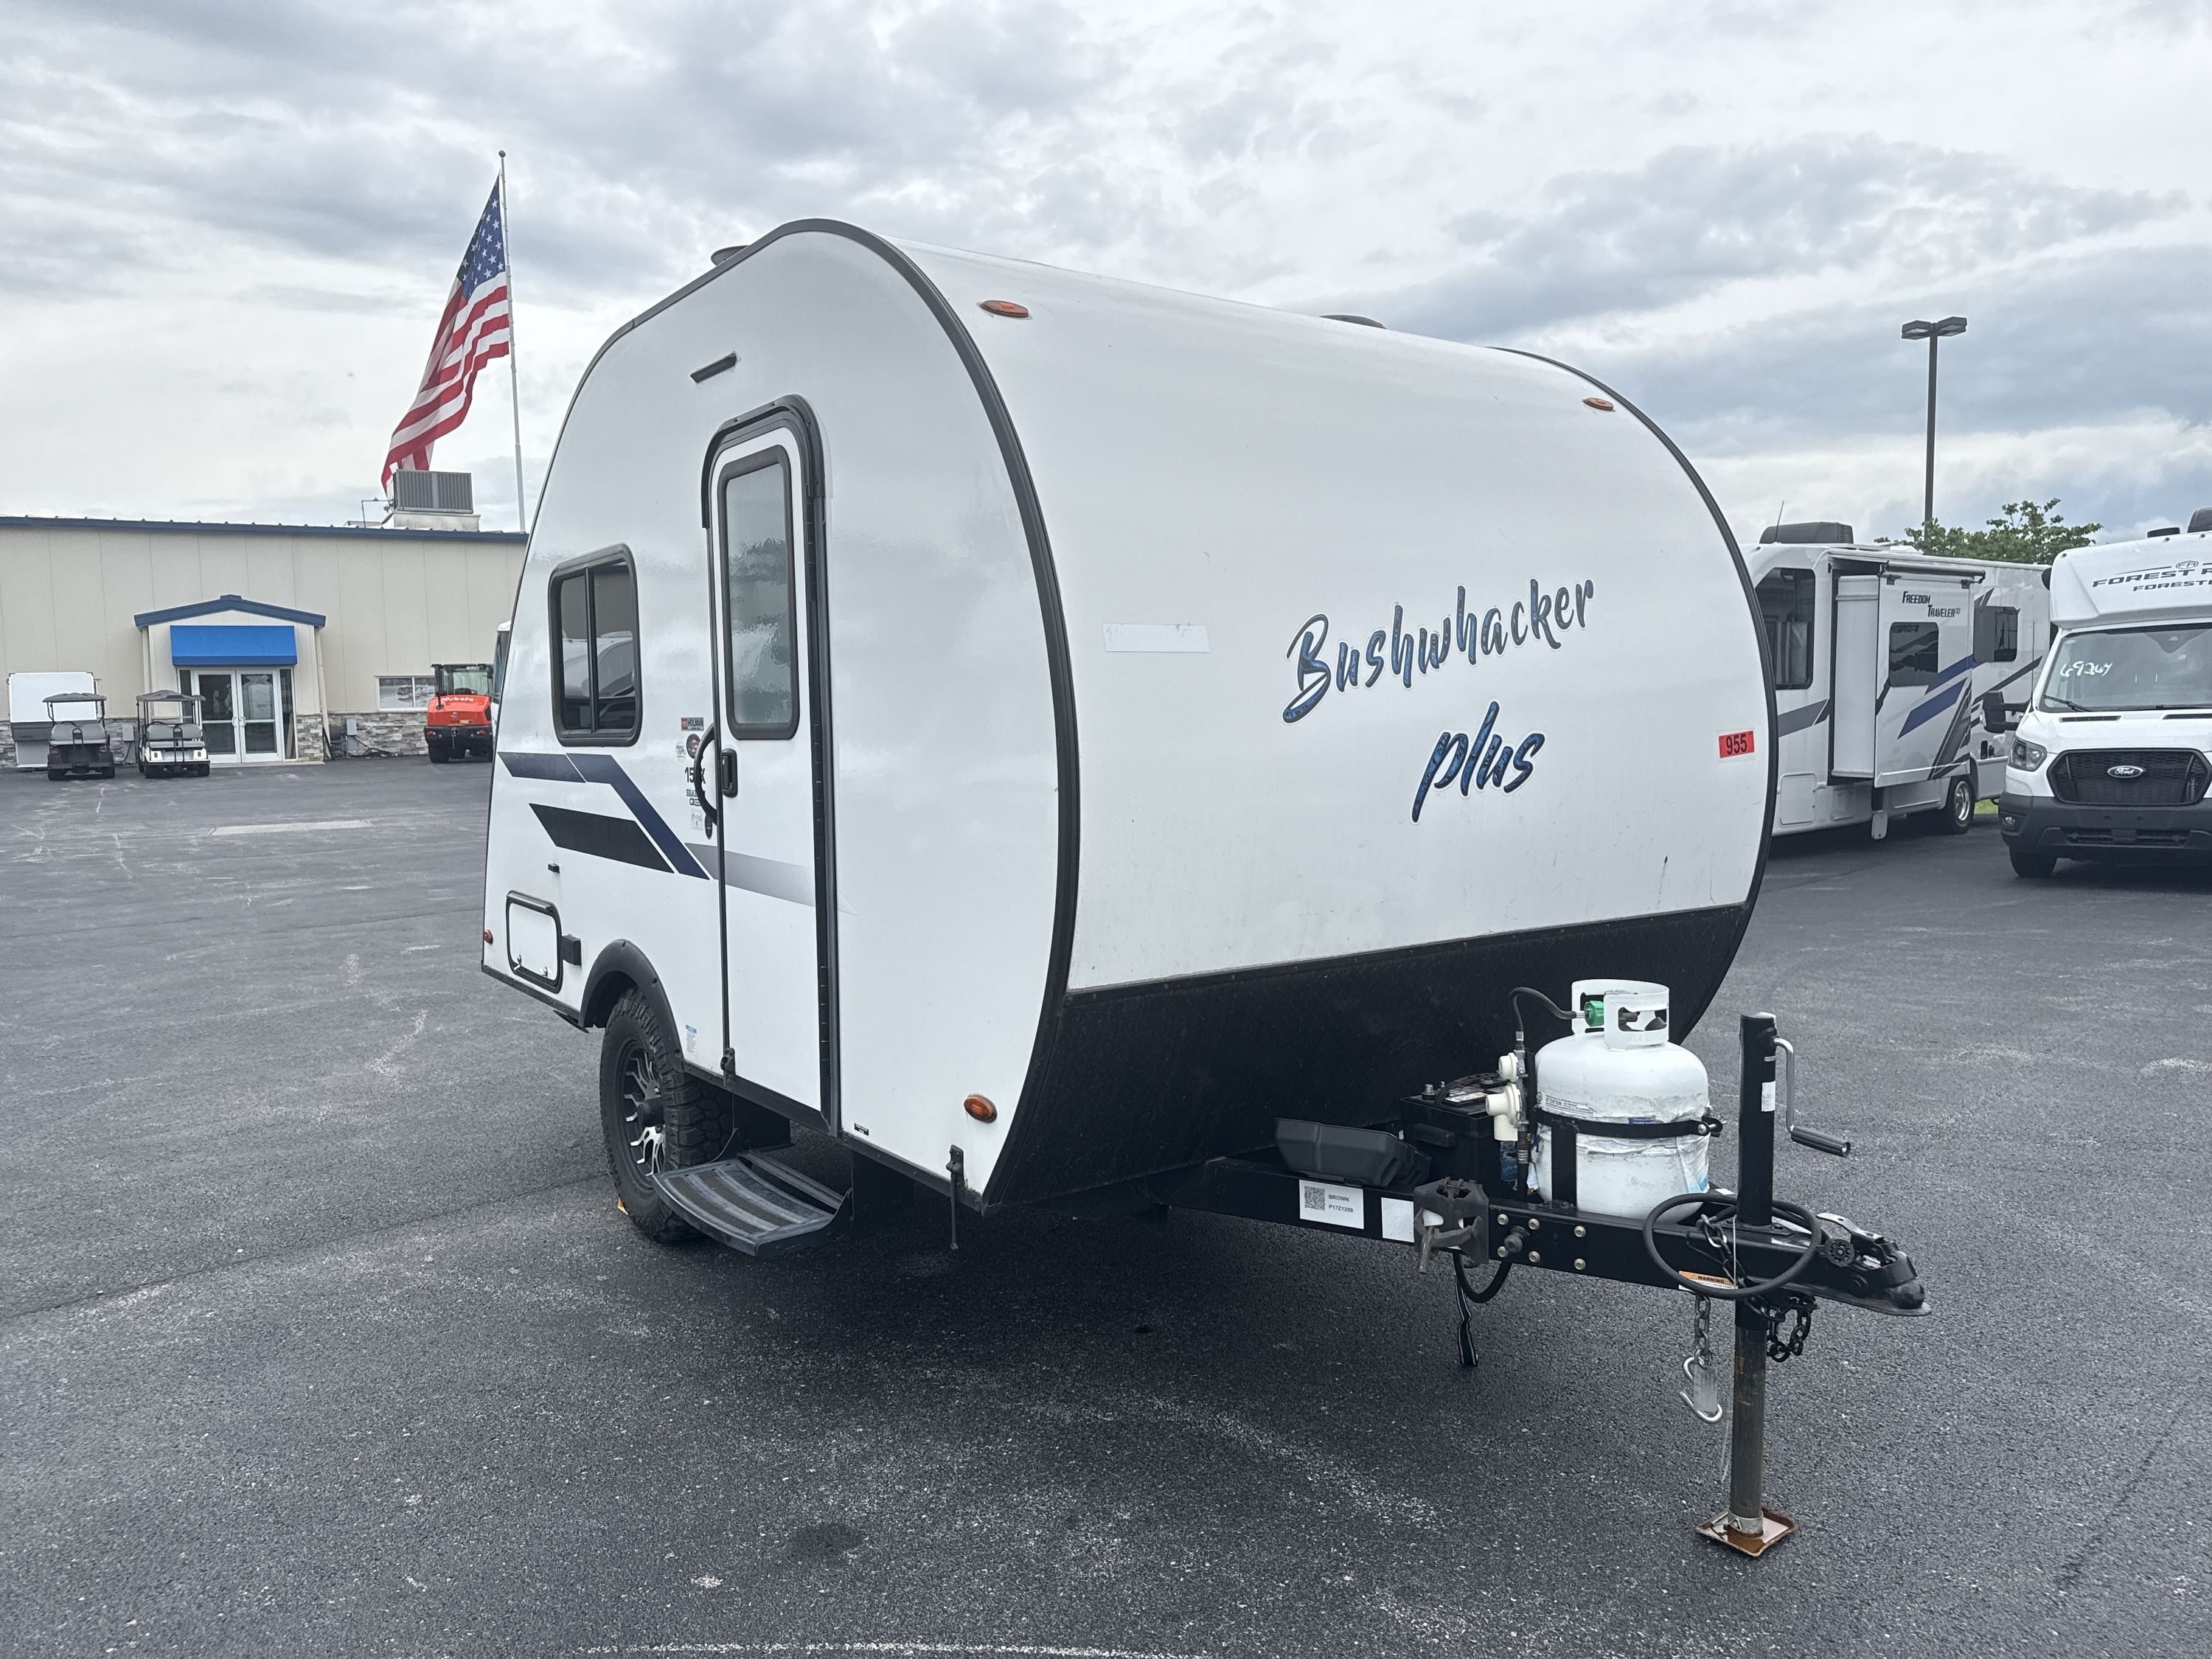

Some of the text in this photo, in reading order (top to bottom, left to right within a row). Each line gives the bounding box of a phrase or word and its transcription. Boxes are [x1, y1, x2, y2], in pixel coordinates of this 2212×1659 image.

[2093, 569, 2195, 588] FOREST
[1902, 591, 1930, 604] FREEDOM
[1927, 605, 1955, 618] TRAVELER
[1283, 578, 1594, 724] Bushwhacker
[1726, 734, 1747, 755] 955
[1411, 700, 1545, 823] plus
[2115, 767, 2135, 775] Ford
[1328, 1194, 1349, 1202] BROWN
[1697, 1275, 1725, 1284] WARNING
